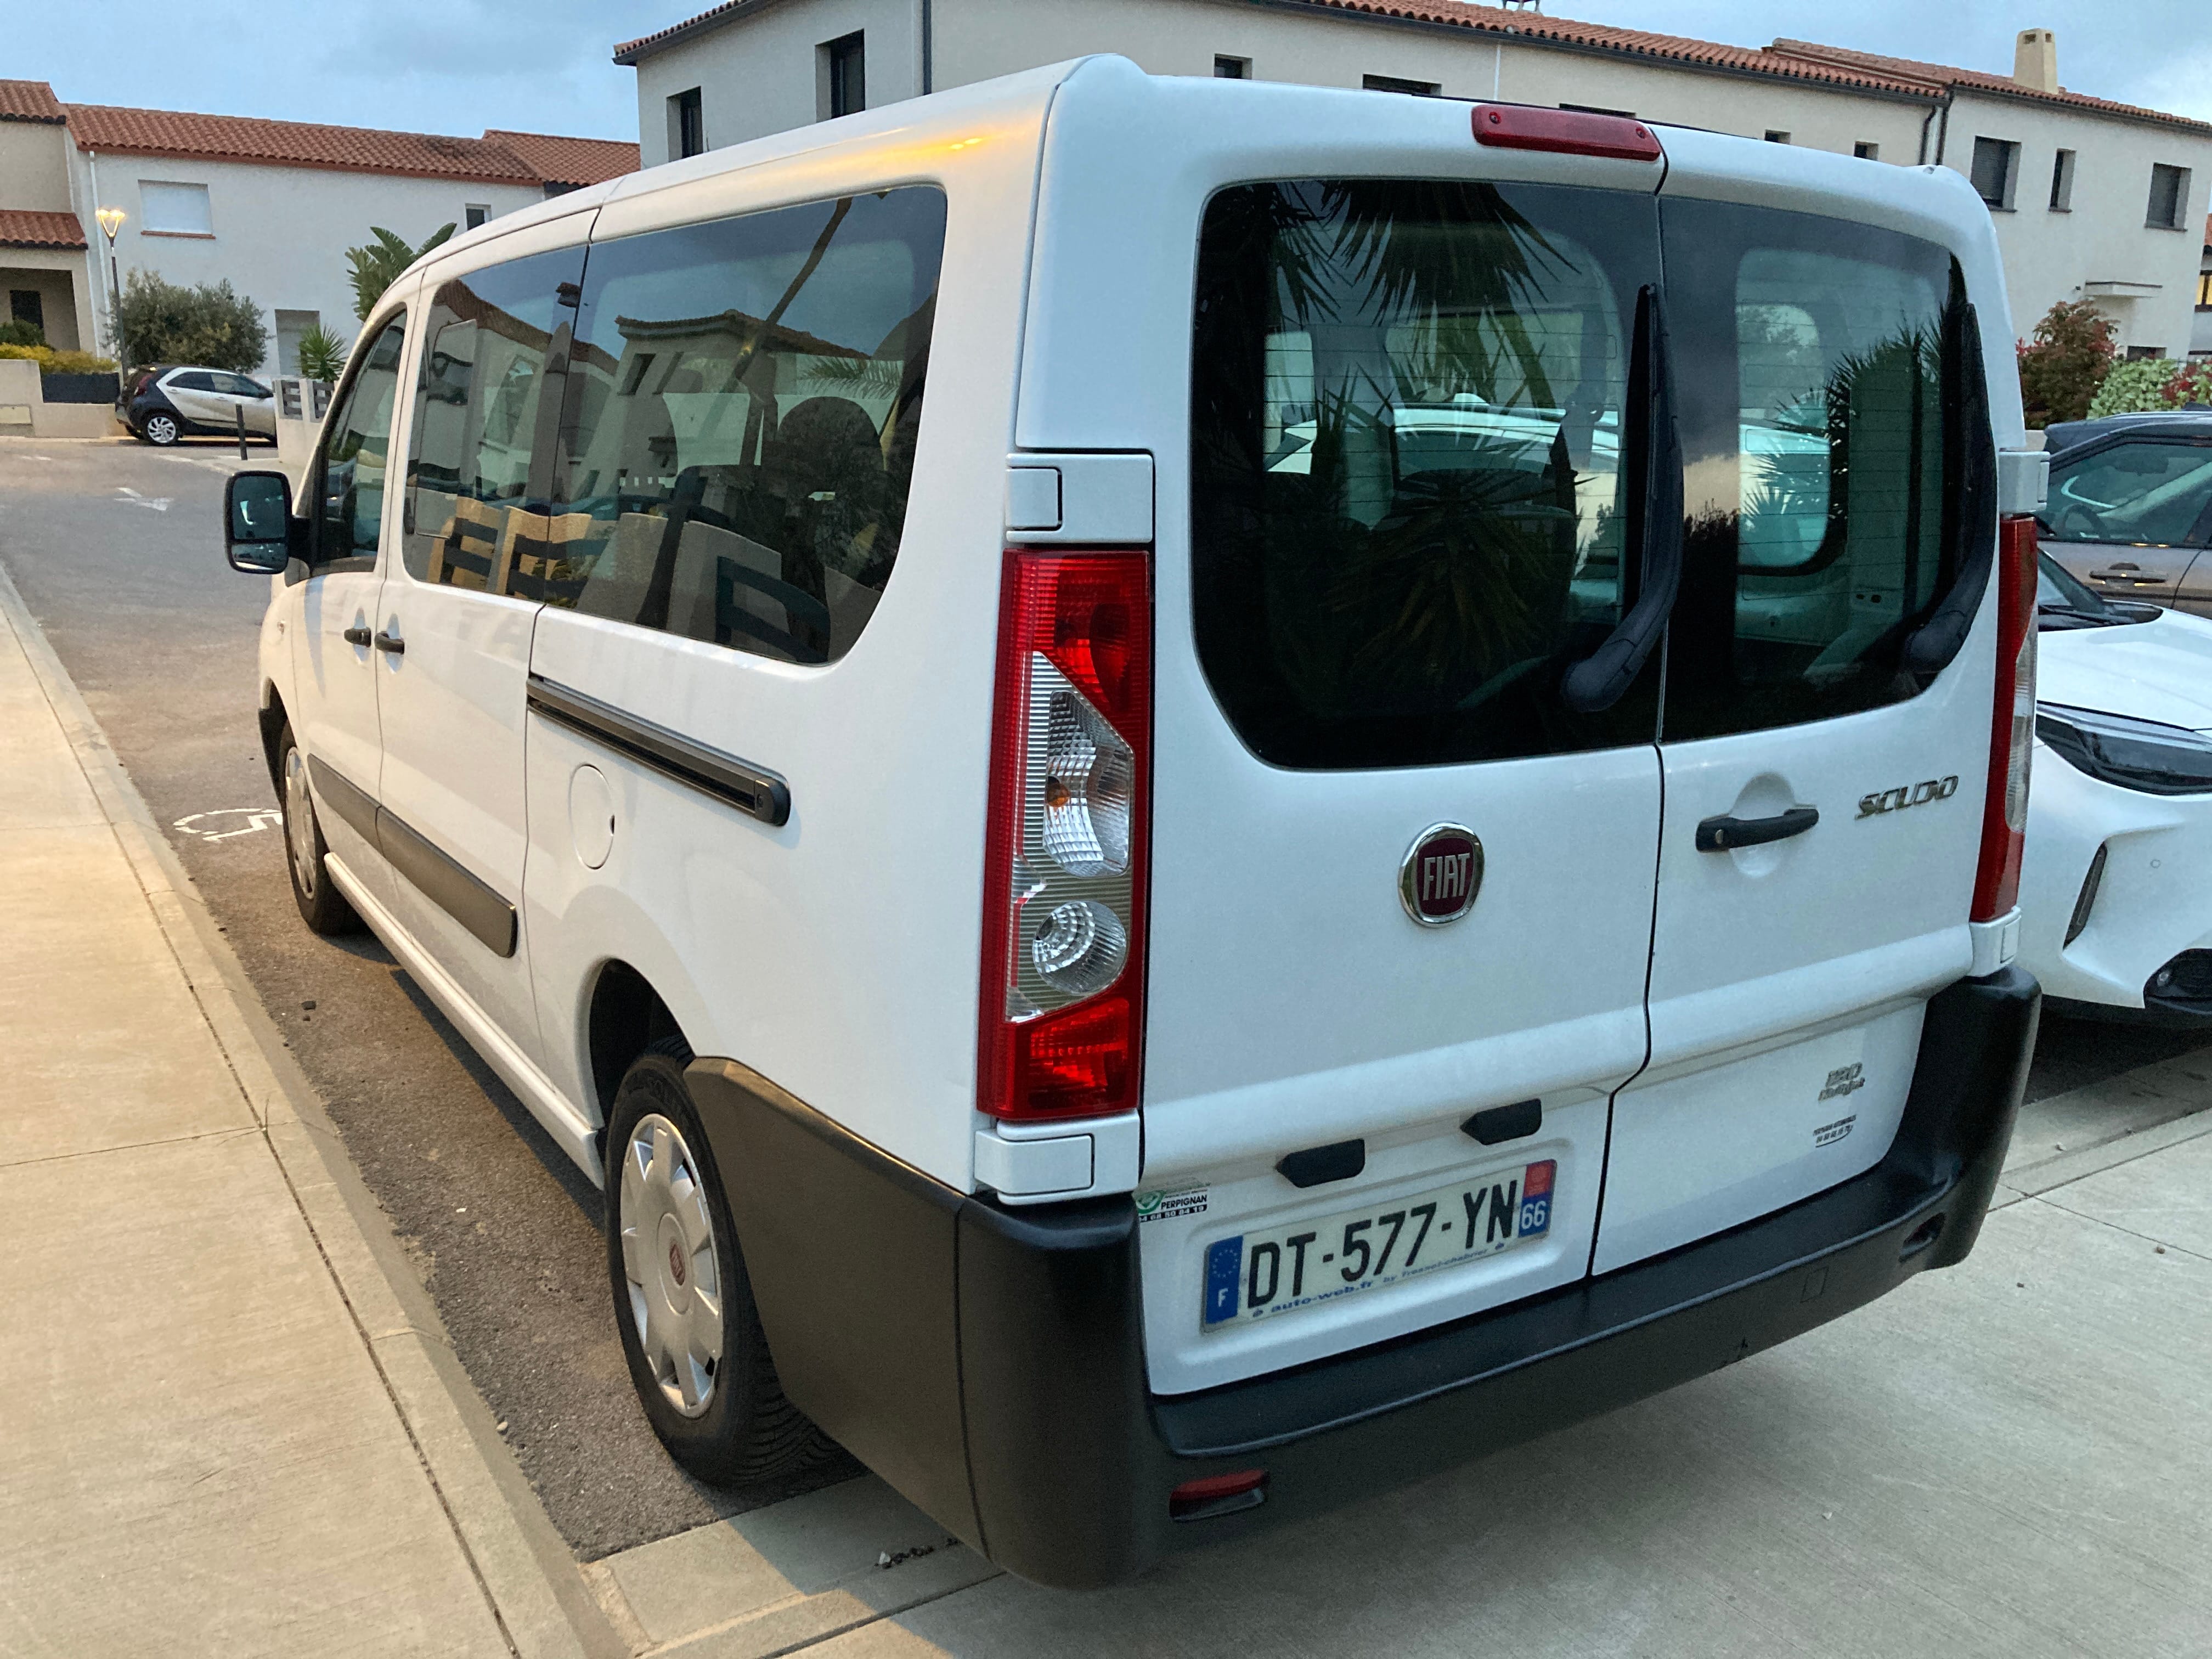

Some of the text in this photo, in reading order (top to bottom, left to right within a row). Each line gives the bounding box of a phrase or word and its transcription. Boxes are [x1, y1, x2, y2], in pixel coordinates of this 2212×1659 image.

[1854, 775, 1959, 820] SCUDO
[1423, 853, 1470, 901] FIAT
[1161, 1194, 1207, 1210] PERPIGNAN
[1521, 1200, 1547, 1229] 66
[1248, 1180, 1517, 1308] DT-577-YN
[1218, 1288, 1228, 1307] F
[1271, 1281, 1373, 1313] auto-web.fr
